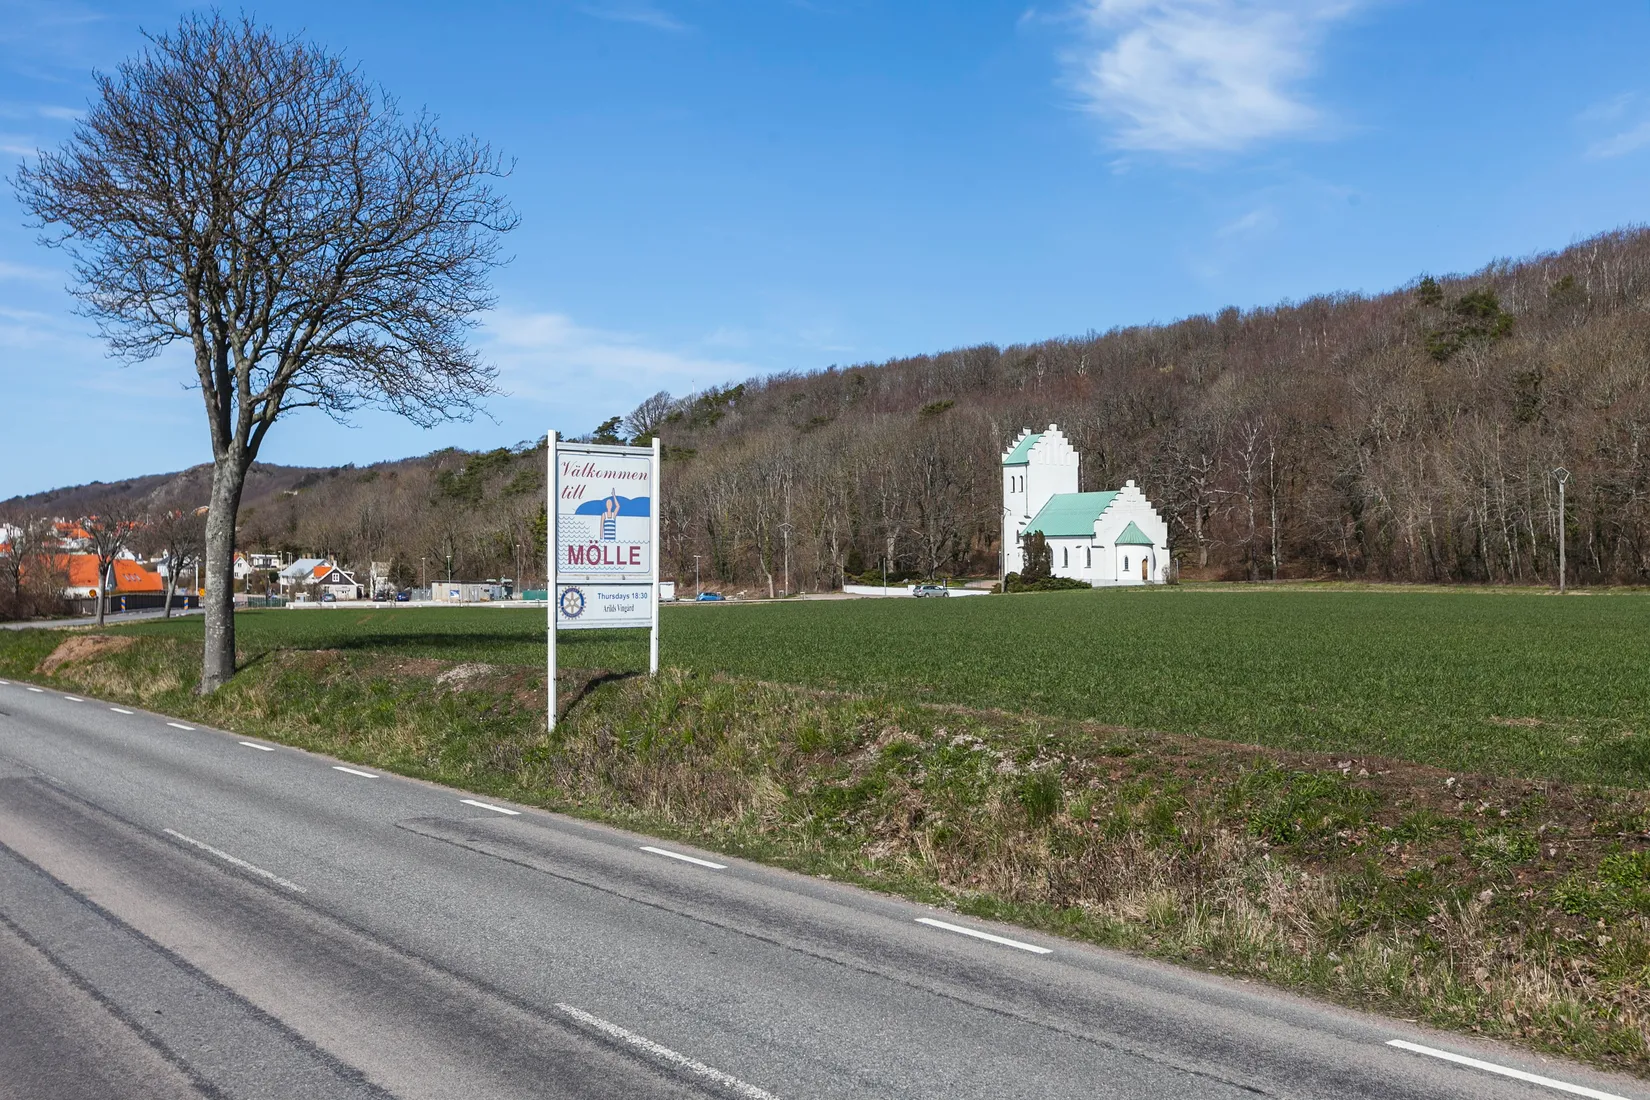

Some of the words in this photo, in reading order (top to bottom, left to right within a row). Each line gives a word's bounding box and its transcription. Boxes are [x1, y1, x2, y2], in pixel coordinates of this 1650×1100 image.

[561, 461, 648, 480] Välkommen
[561, 484, 586, 499] till
[567, 540, 641, 565] MÖLLE
[597, 592, 630, 600] Thursdays
